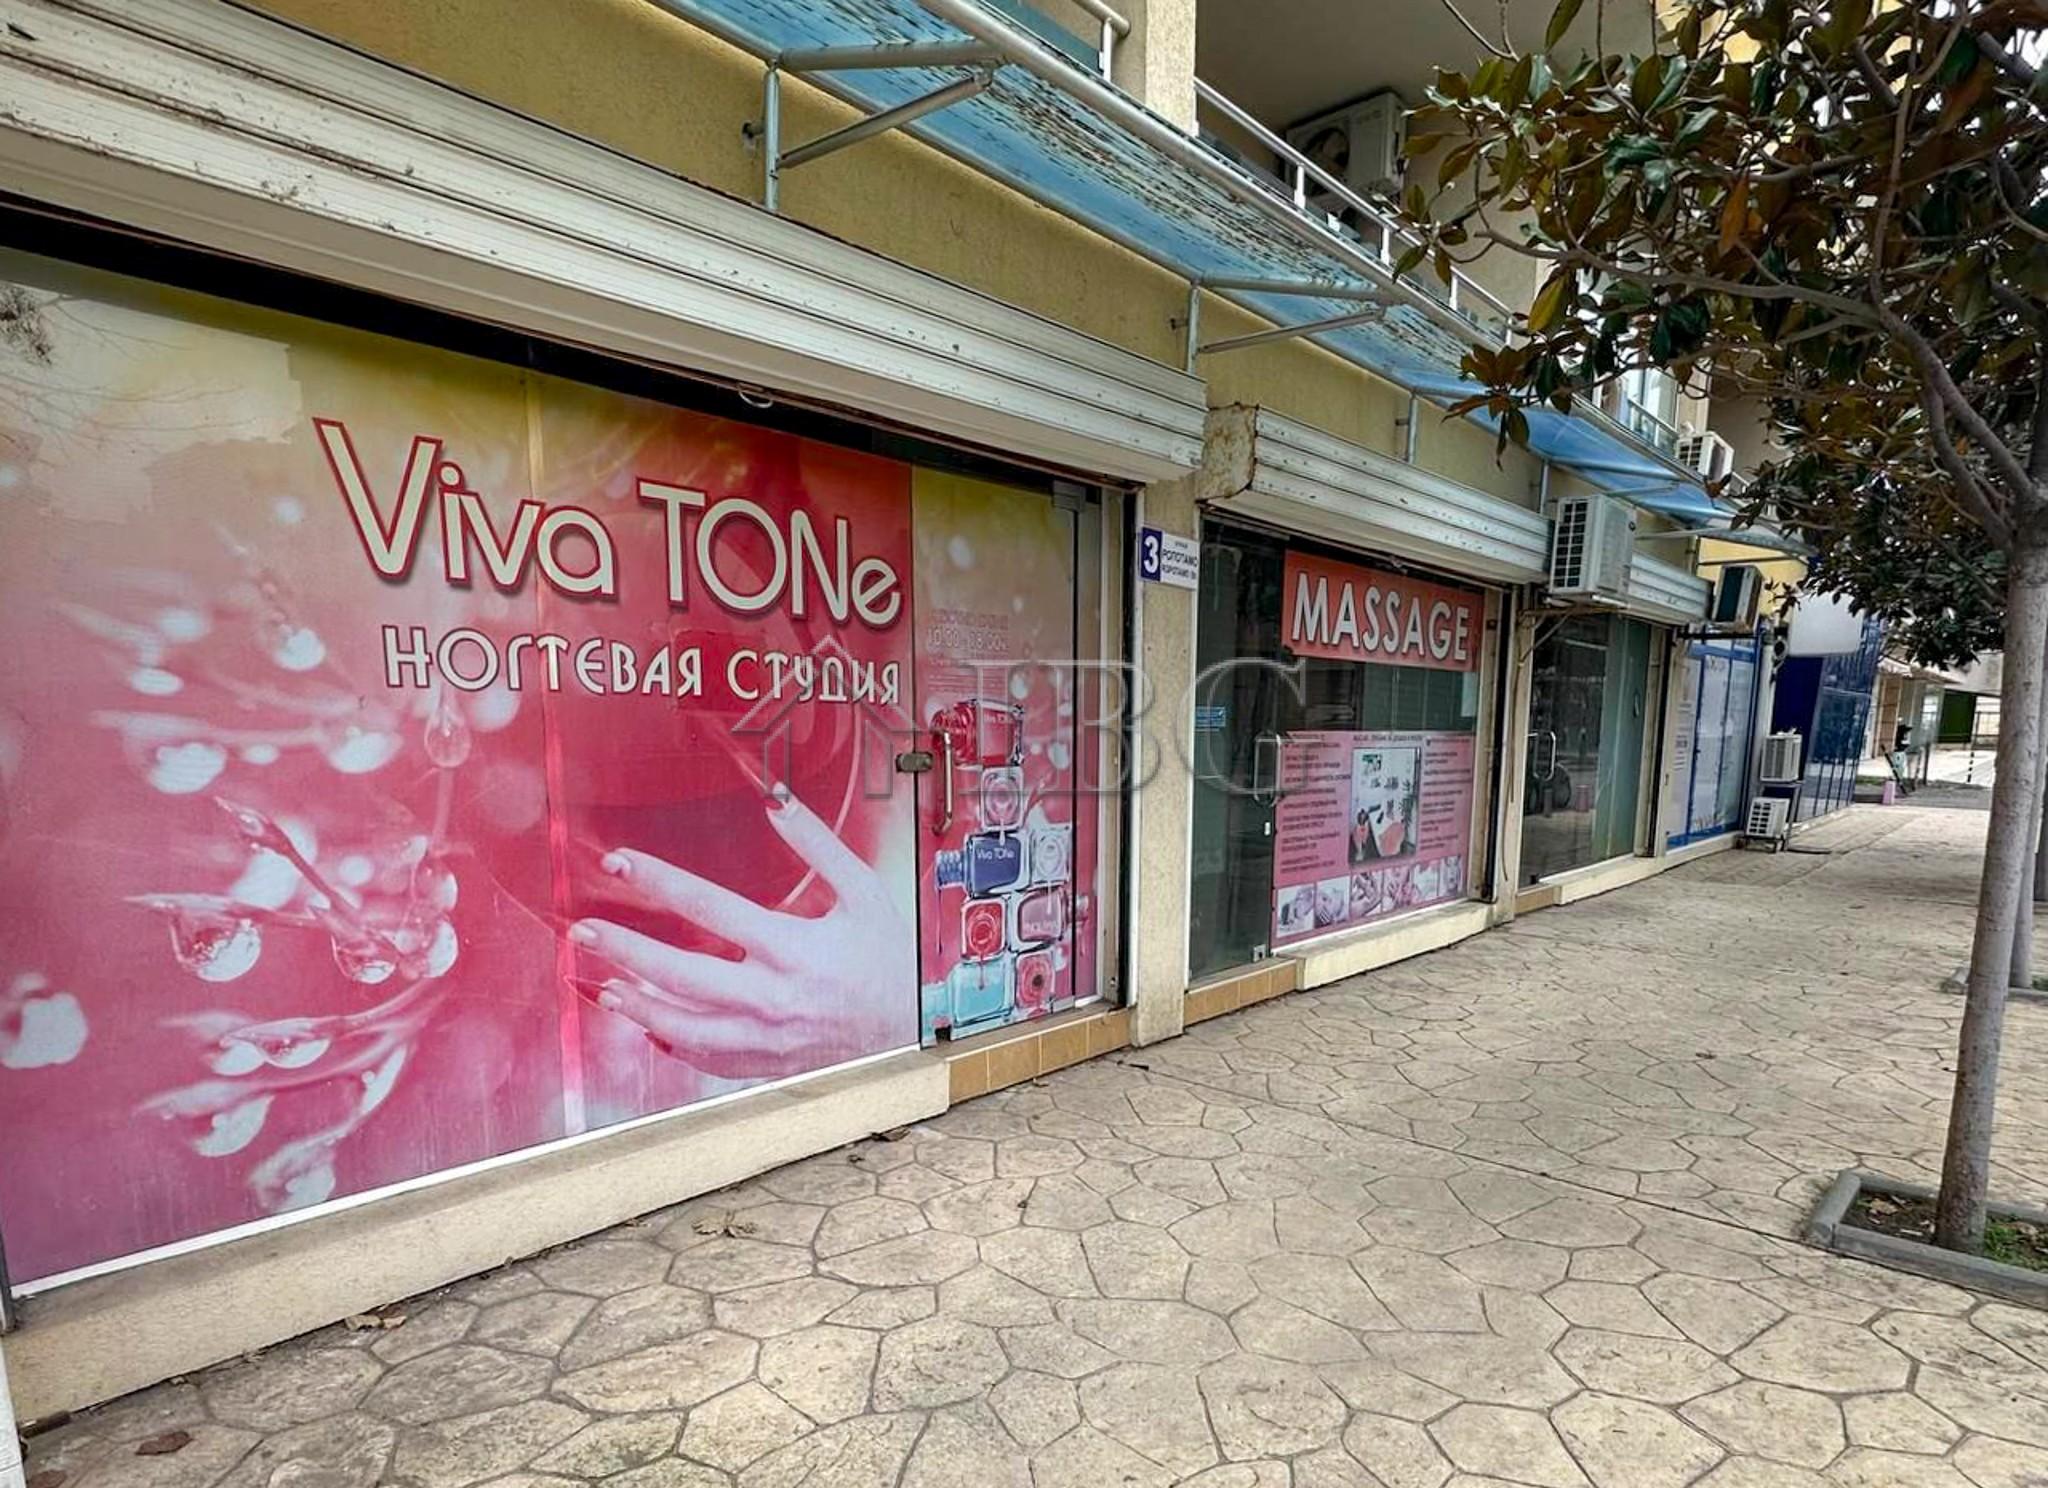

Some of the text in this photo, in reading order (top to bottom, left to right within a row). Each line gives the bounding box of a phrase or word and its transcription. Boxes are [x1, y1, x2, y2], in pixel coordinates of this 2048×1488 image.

[312, 417, 615, 596] Viva
[1143, 535, 1159, 573] 3
[1291, 571, 1470, 662] MASSAGE
[727, 647, 901, 705] СТУДИЯ
